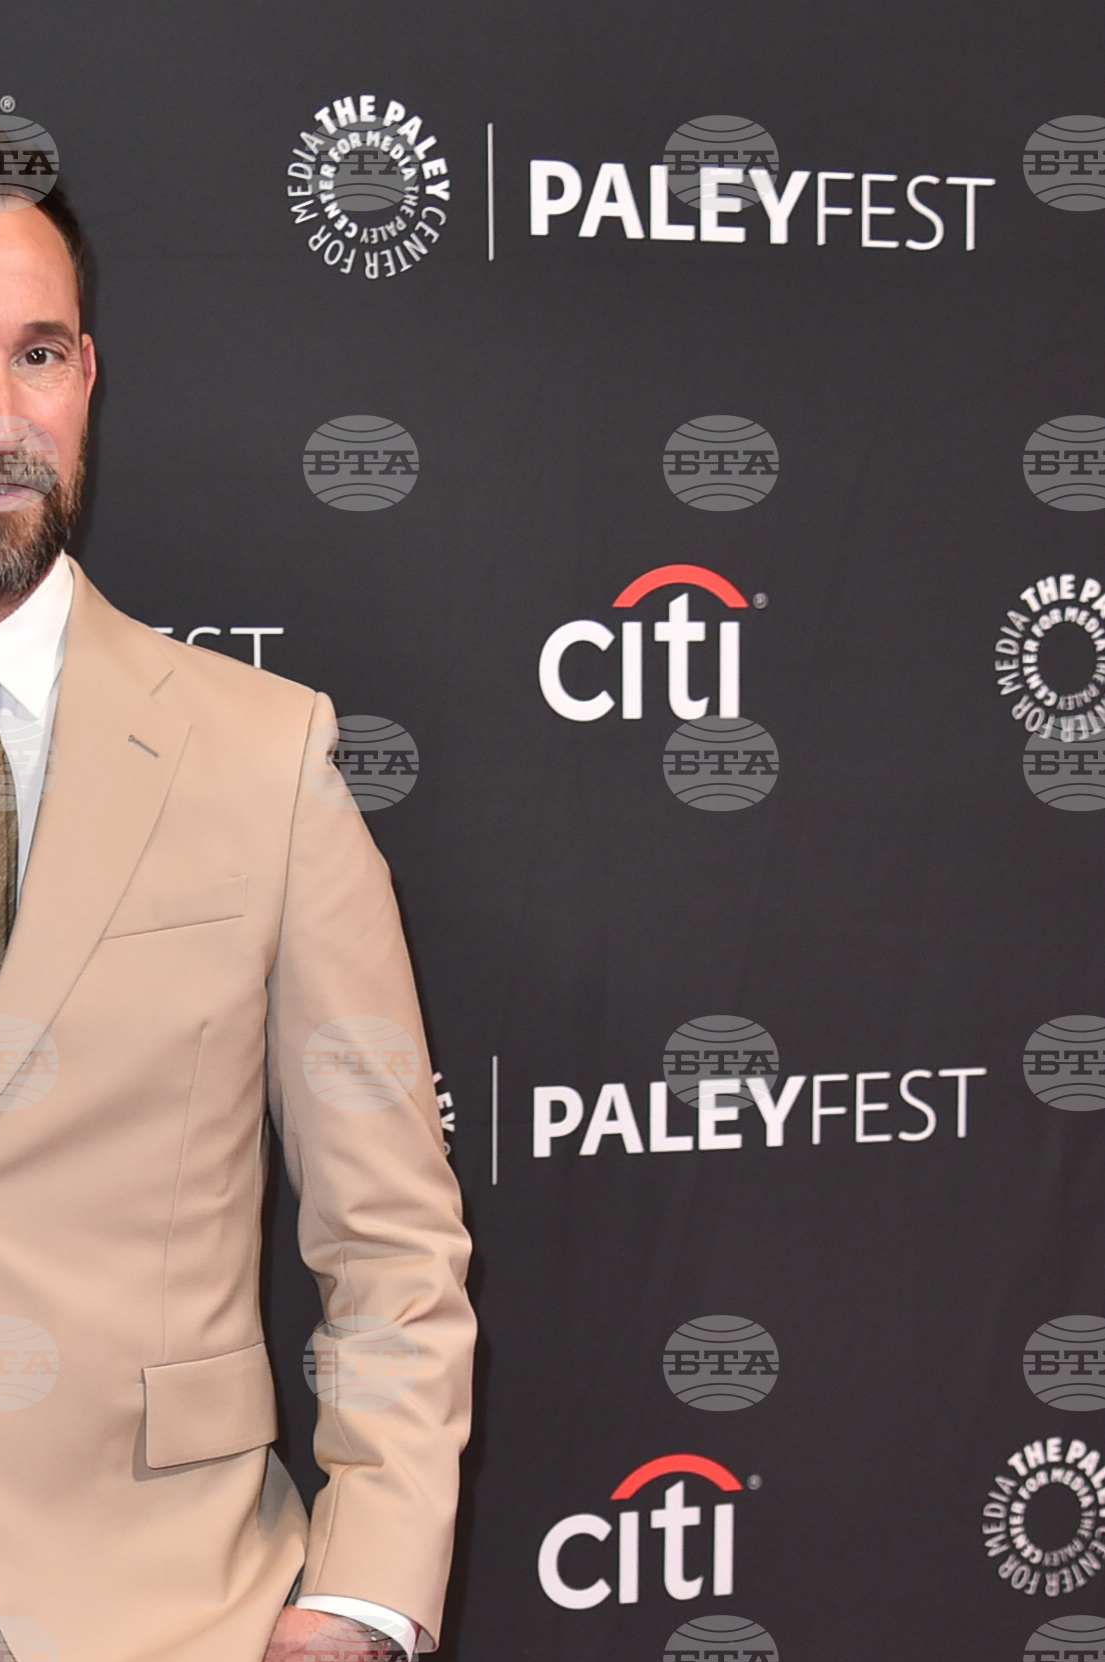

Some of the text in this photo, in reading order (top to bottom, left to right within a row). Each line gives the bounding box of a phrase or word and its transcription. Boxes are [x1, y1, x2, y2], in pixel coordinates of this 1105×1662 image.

[287, 95, 450, 279] THE PALEY CENTER FOR MEDIA
[328, 132, 362, 163] FOR
[366, 131, 417, 181] MEDIA
[529, 158, 996, 252] PALEYFEST
[1020, 574, 1076, 612] THE
[538, 592, 741, 723] citi
[995, 610, 1031, 695] MEDIA
[1011, 695, 1055, 739] FOR
[532, 1067, 987, 1158] PALEYFEST
[1007, 1437, 1062, 1476] THE
[537, 1480, 734, 1610] citi
[982, 1476, 1018, 1557] MEDIA
[998, 1554, 1040, 1595] FOR
